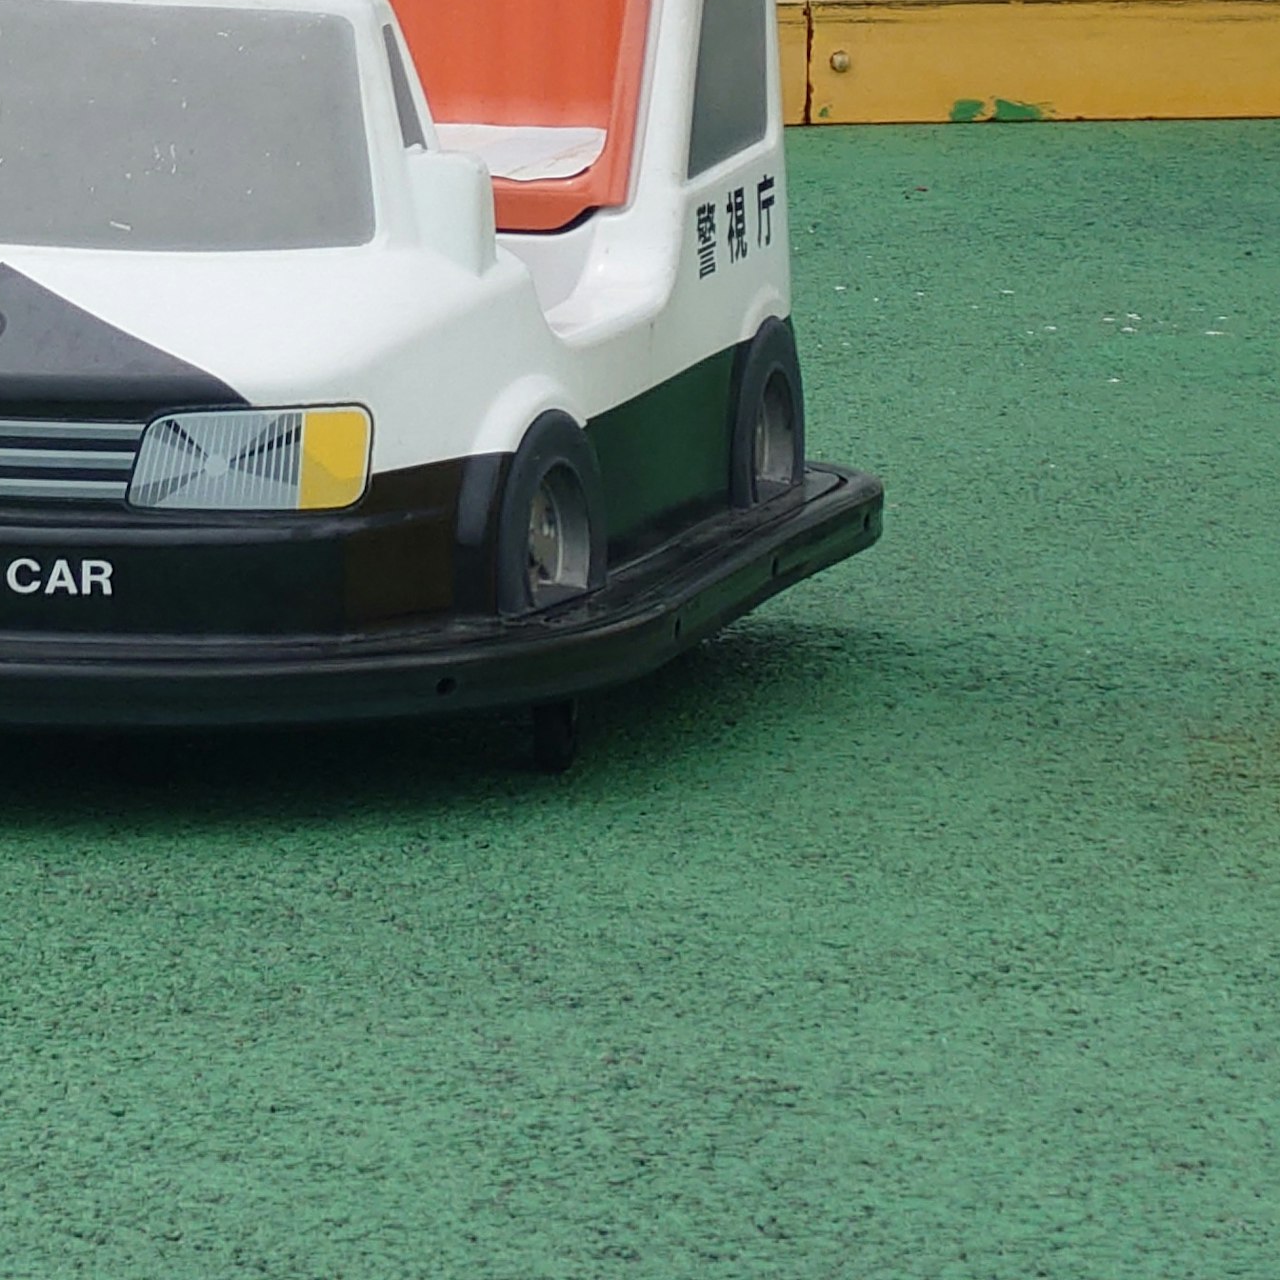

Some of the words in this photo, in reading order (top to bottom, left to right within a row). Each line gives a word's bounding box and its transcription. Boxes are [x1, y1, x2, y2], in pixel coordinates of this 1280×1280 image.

[695, 174, 776, 281] 警視庁
[6, 557, 114, 596] CAR
